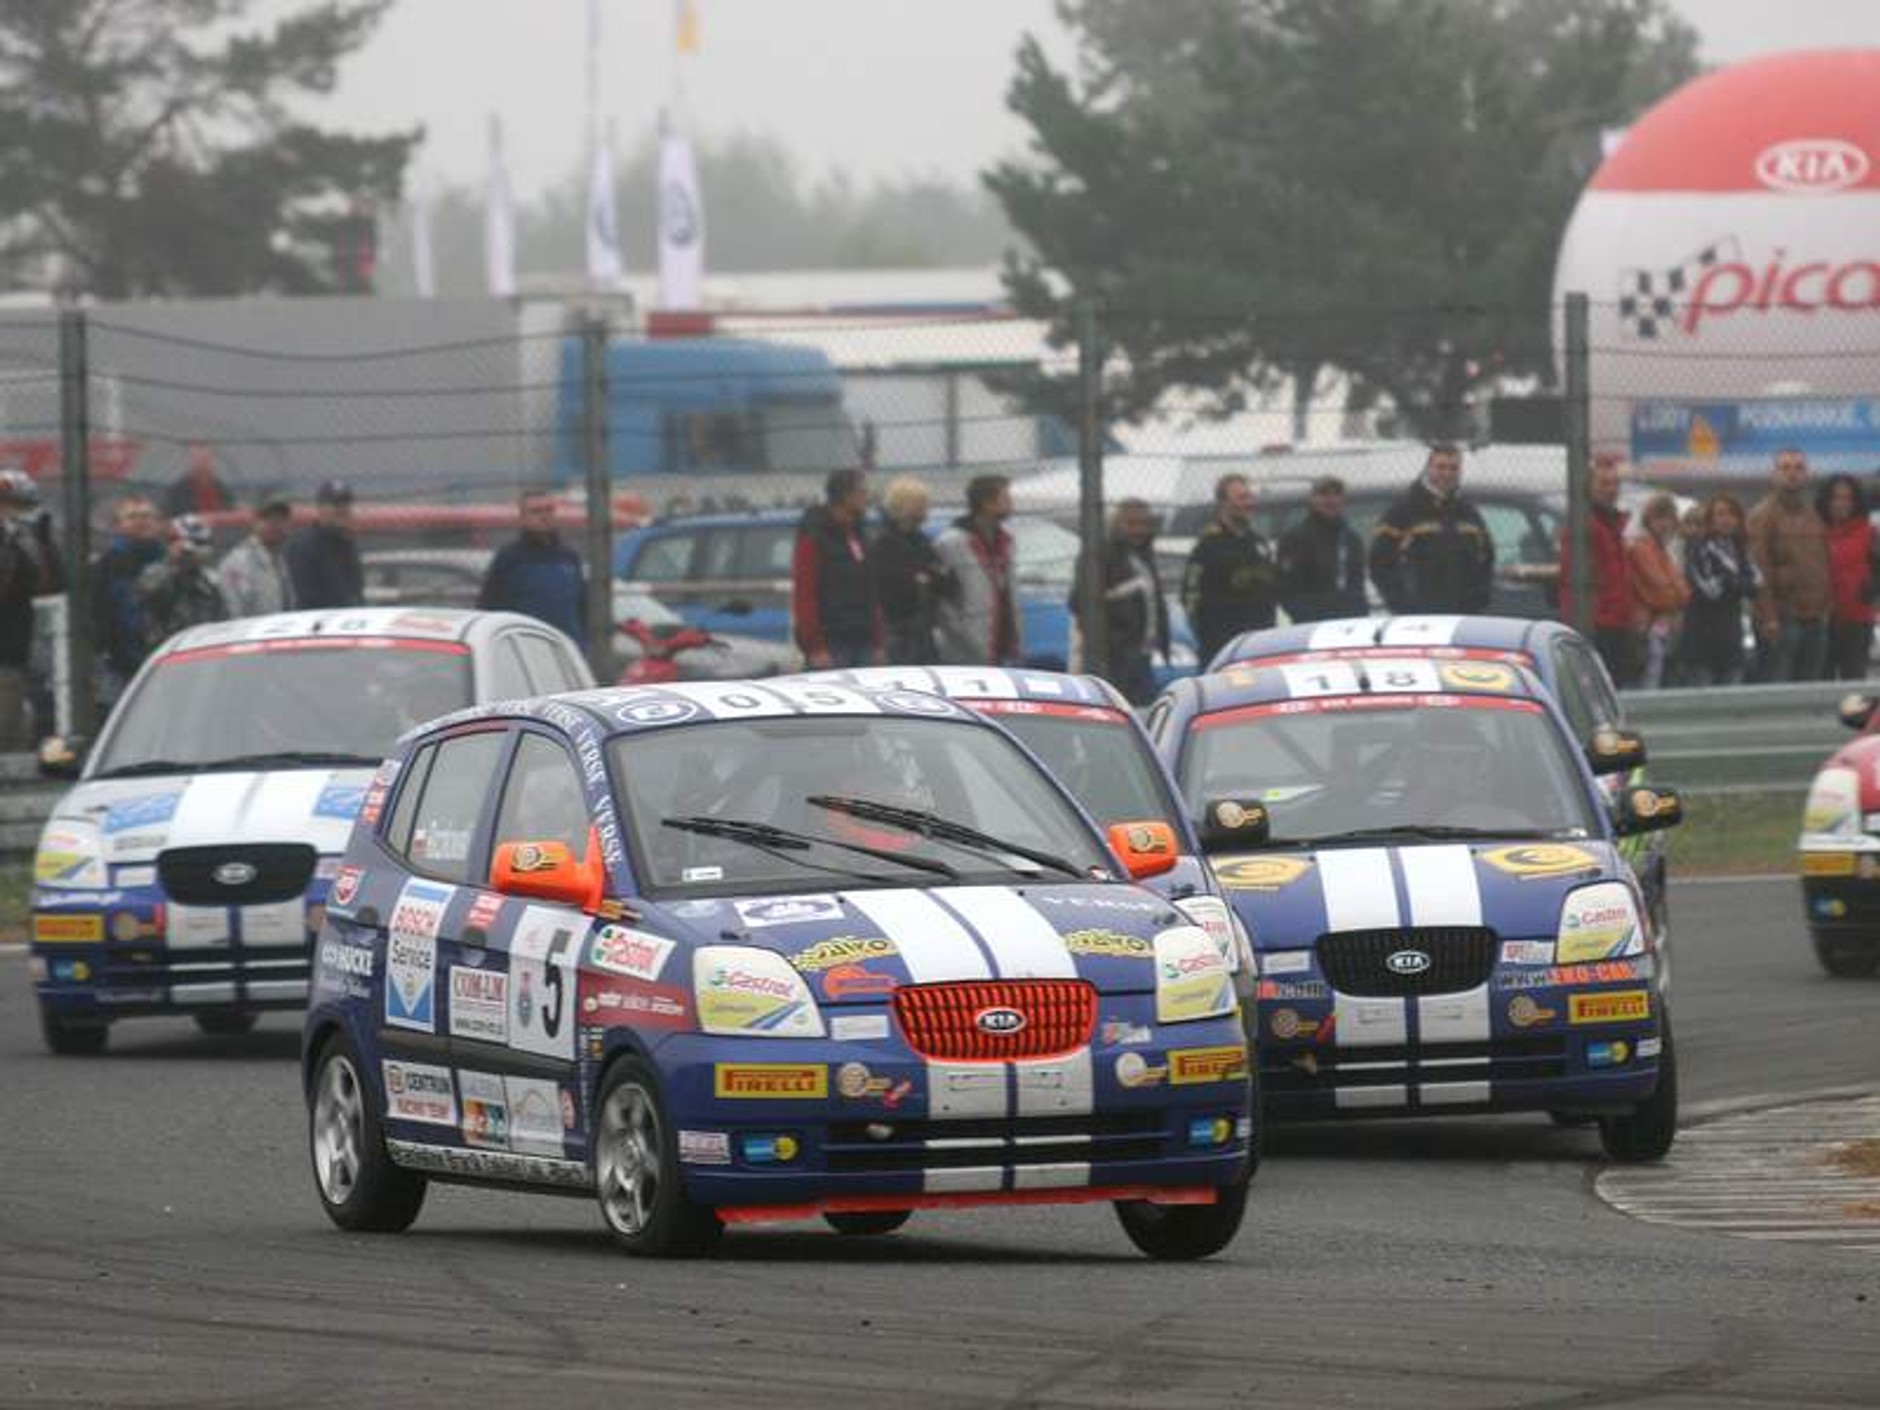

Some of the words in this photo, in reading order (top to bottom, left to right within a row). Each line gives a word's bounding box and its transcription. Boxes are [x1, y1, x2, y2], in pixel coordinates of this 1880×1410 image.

[1774, 148, 1850, 177] KIA
[391, 939, 432, 970] Service
[543, 928, 573, 1038] 5
[724, 969, 794, 998] Castrol
[1577, 995, 1646, 1017] PIRELLI
[722, 1068, 817, 1093] PIRELLI
